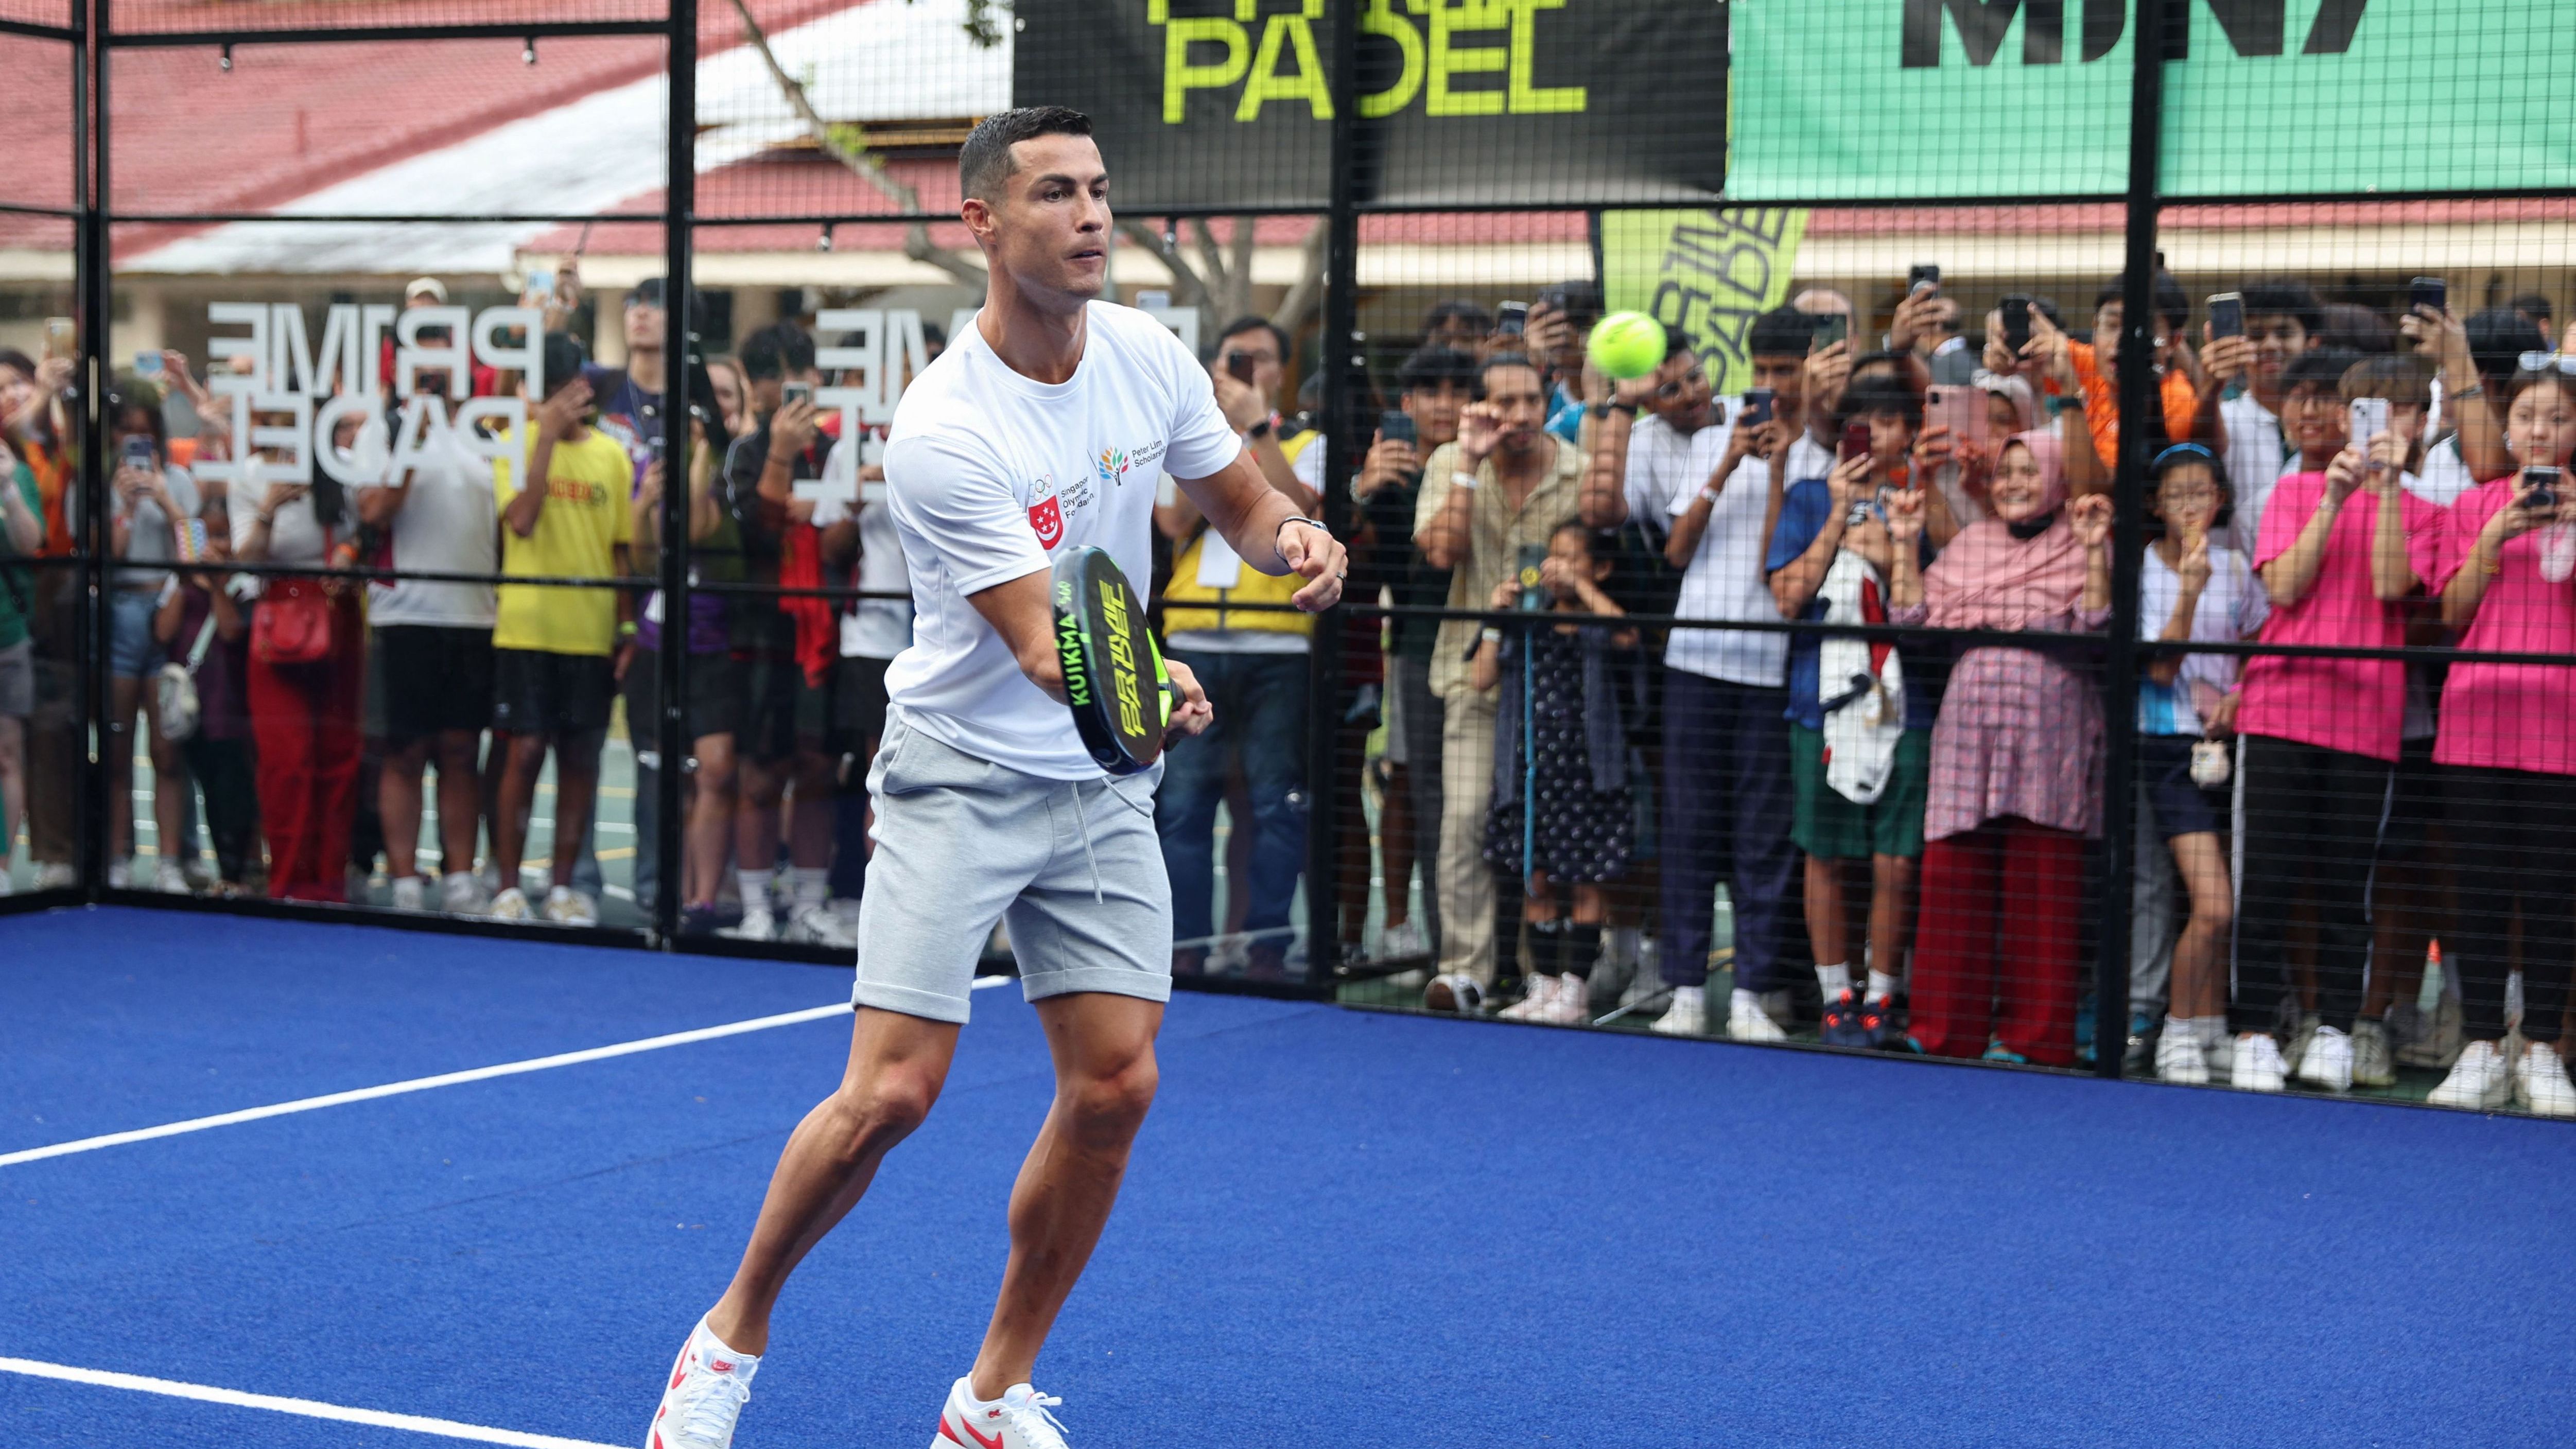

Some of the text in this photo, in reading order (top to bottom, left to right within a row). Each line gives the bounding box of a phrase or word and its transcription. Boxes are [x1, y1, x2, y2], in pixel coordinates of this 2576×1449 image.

[1162, 4, 1587, 124] PADEL
[1132, 440, 1162, 458] Peter Lim
[1135, 446, 1166, 467] Scholarsh
[1061, 476, 1088, 498] Singapor
[1063, 488, 1088, 508] Olymic
[1058, 614, 1091, 706] KUIKMA
[1099, 579, 1137, 738] PRIME
[1111, 583, 1146, 736] PADEL
